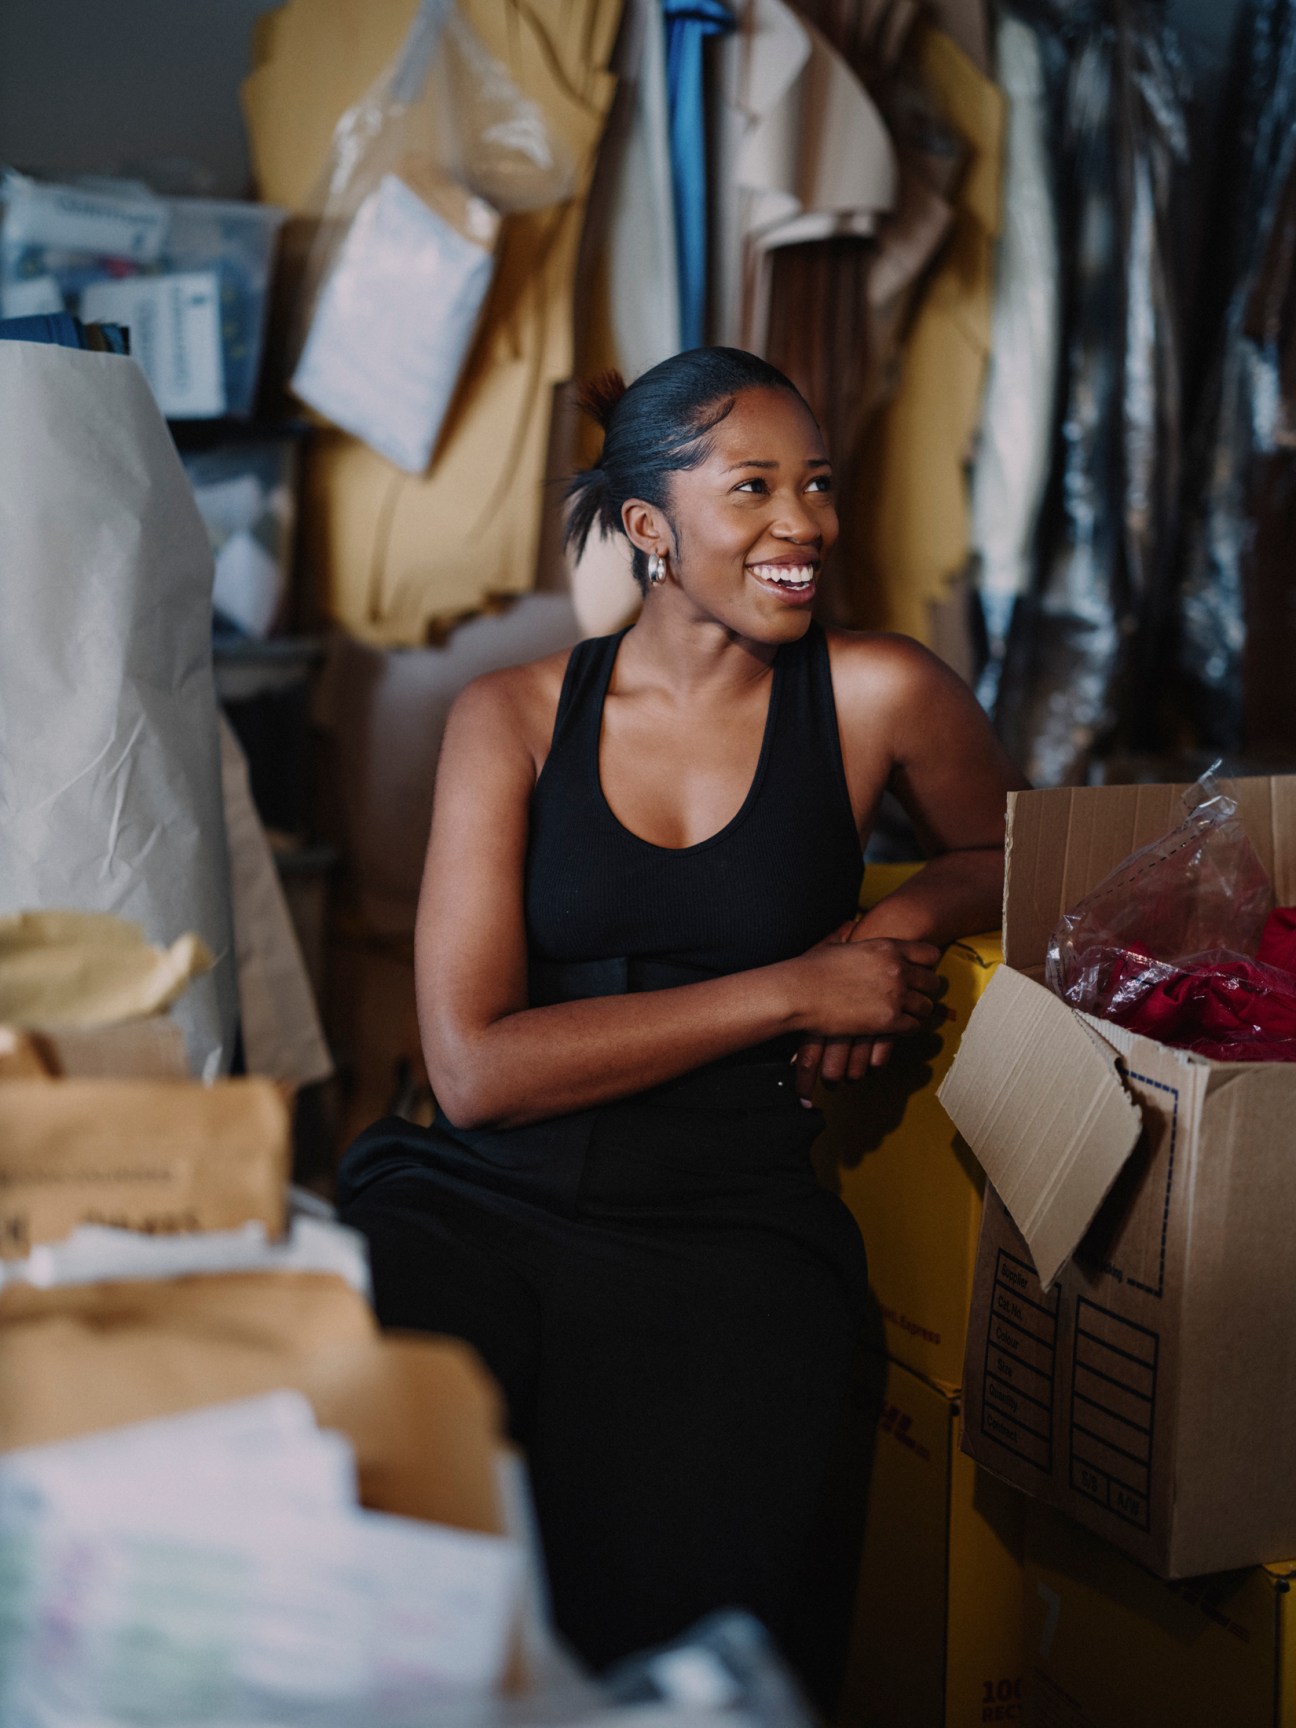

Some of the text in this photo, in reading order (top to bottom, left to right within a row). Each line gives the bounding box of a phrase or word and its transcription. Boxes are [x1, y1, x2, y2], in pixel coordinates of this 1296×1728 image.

[1001, 1263, 1028, 1289] Supplier
[996, 1327, 1019, 1349] Colour
[997, 1358, 1013, 1377] Size
[989, 1384, 1018, 1413] Quantity
